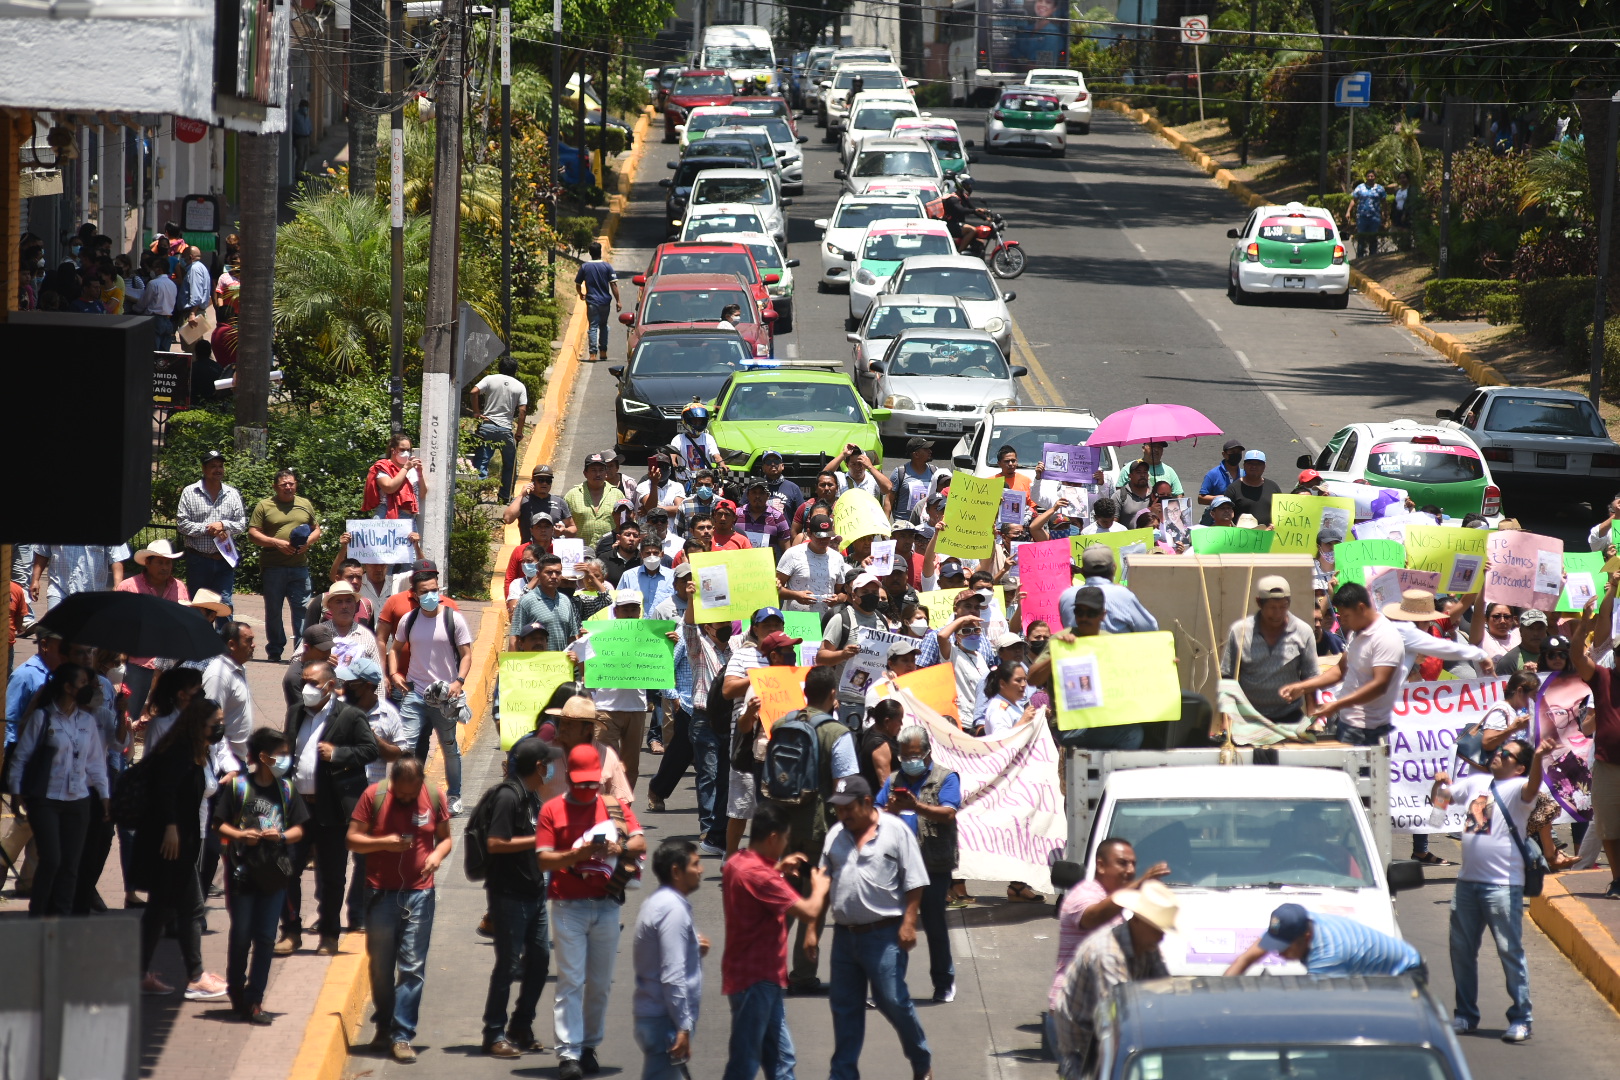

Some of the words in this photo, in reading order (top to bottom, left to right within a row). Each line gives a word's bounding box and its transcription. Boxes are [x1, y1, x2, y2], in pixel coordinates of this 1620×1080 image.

[1340, 75, 1365, 104] E
[153, 372, 178, 380] OMIDA
[153, 386, 172, 394] AÑO
[964, 478, 988, 494] VIVA
[1278, 500, 1303, 514] NOS
[836, 506, 857, 525] ALTA
[960, 509, 977, 521] VIVA
[1277, 515, 1312, 528] FALTA
[956, 524, 988, 536] QUEREMOS
[1276, 531, 1310, 548] VIRI
[1410, 531, 1442, 548] NOS
[1447, 533, 1486, 554] FALTA
[1028, 546, 1054, 558] VIVA
[1036, 580, 1056, 591] VIVA
[1039, 599, 1052, 608] LA
[786, 625, 812, 636] SPERA
[506, 660, 522, 672] NO
[529, 662, 571, 674] ESTAMOS
[518, 678, 556, 690] TODAS
[757, 674, 780, 688] NOS
[762, 690, 790, 704] FALTA
[1392, 681, 1508, 716] USCA!!
[506, 701, 526, 712] NOS
[1390, 814, 1426, 828] ACTO:
